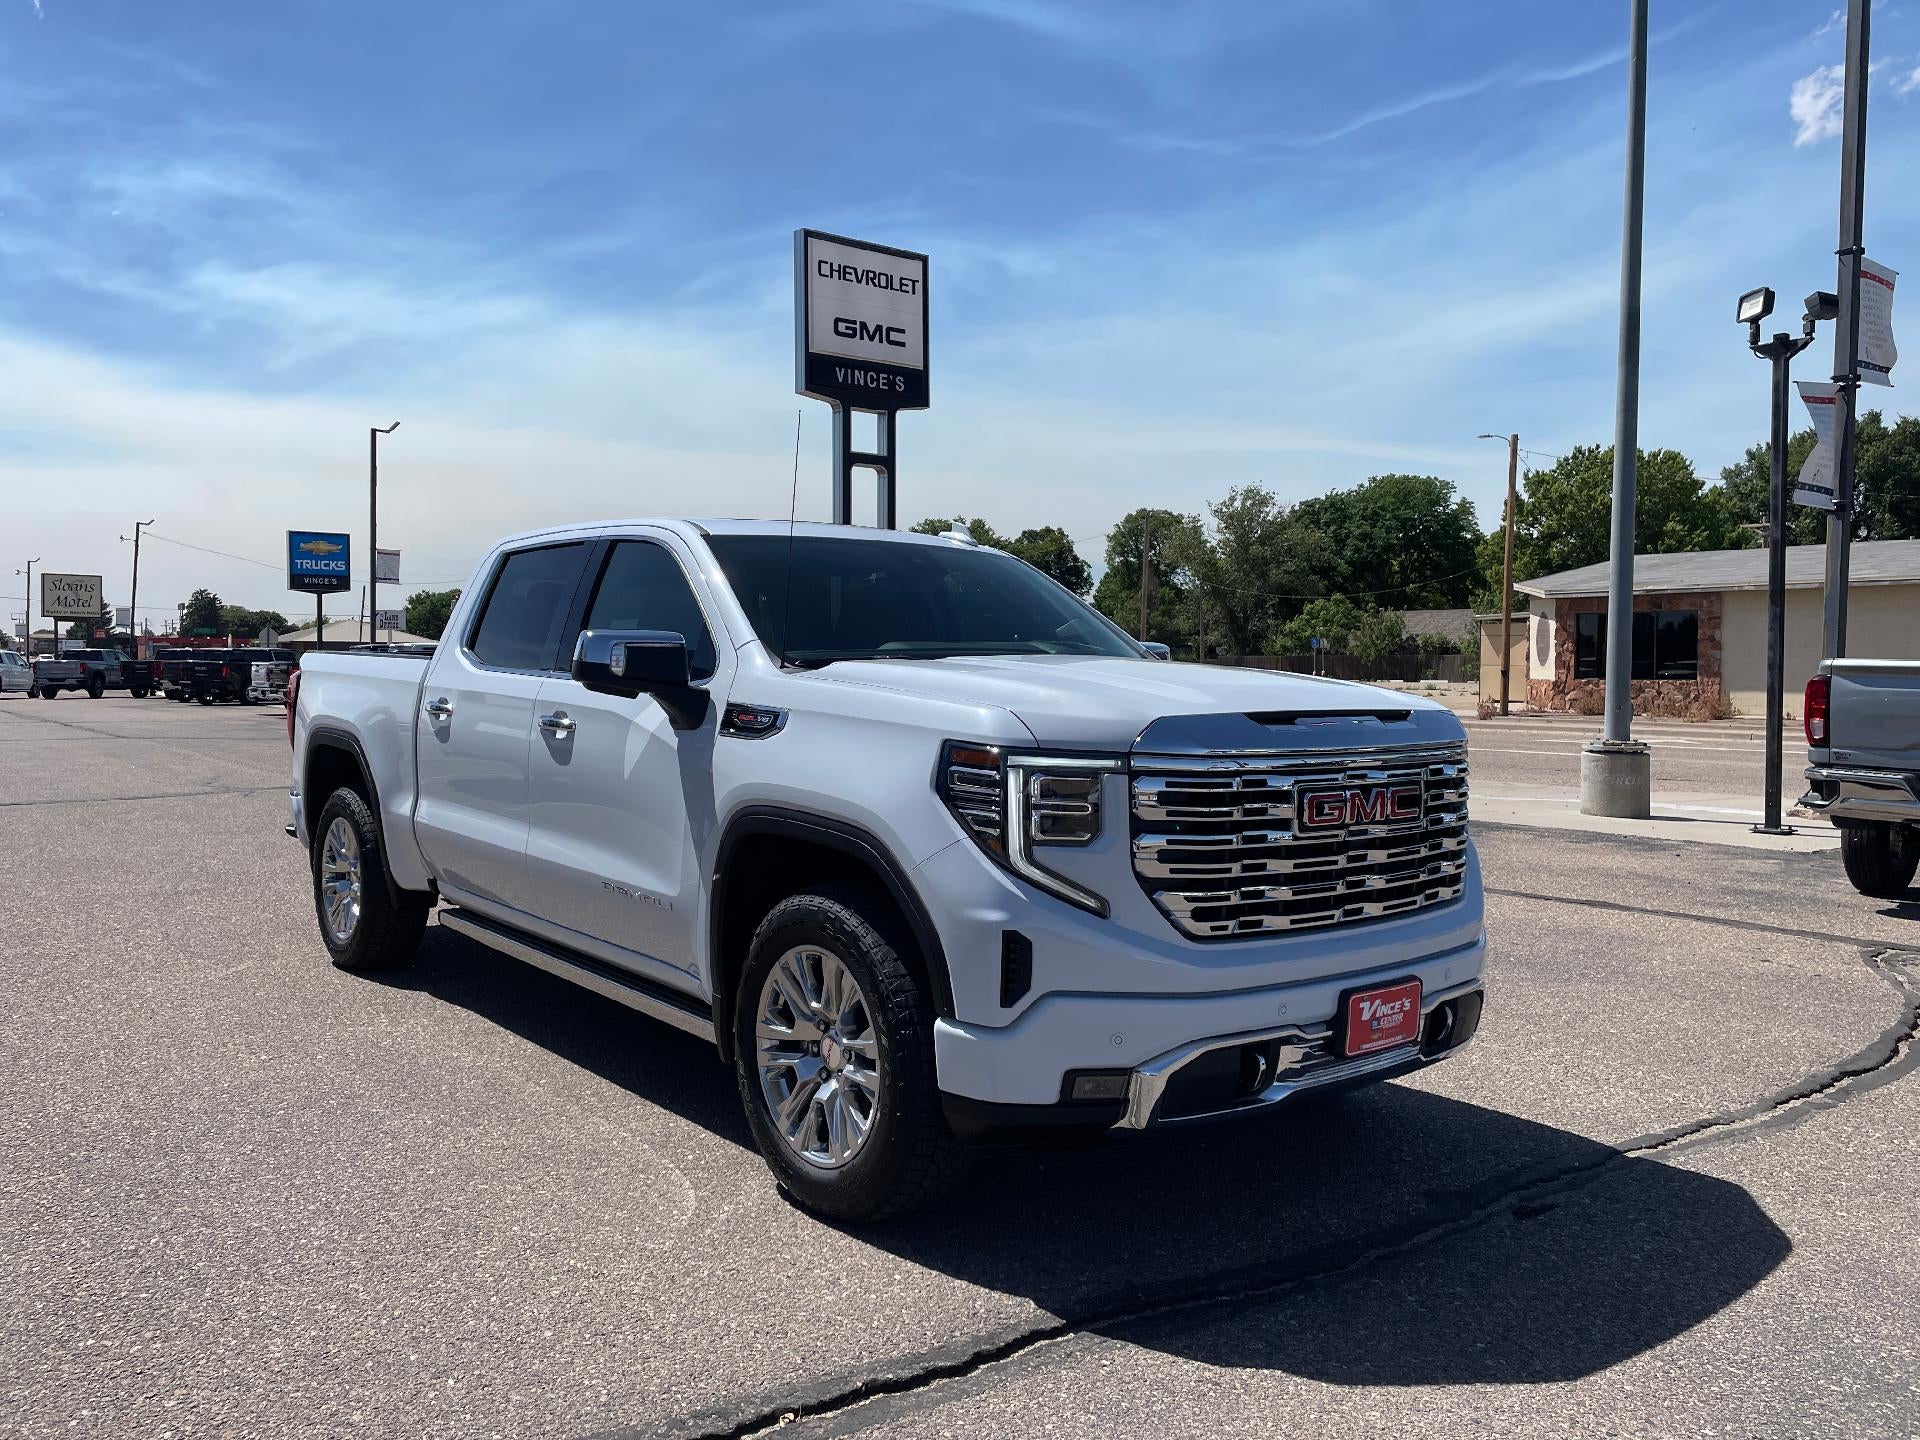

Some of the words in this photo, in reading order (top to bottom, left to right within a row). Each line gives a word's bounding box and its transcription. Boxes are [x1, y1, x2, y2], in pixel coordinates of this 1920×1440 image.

[817, 259, 920, 295] CHEVROLET
[833, 316, 906, 348] GMC
[835, 366, 905, 392] VINCE'S
[294, 559, 346, 571] TRUCKS
[49, 578, 95, 593] Sloans
[303, 577, 338, 585] VINCE'S
[51, 595, 92, 608] Motel
[1304, 786, 1420, 827] GMC
